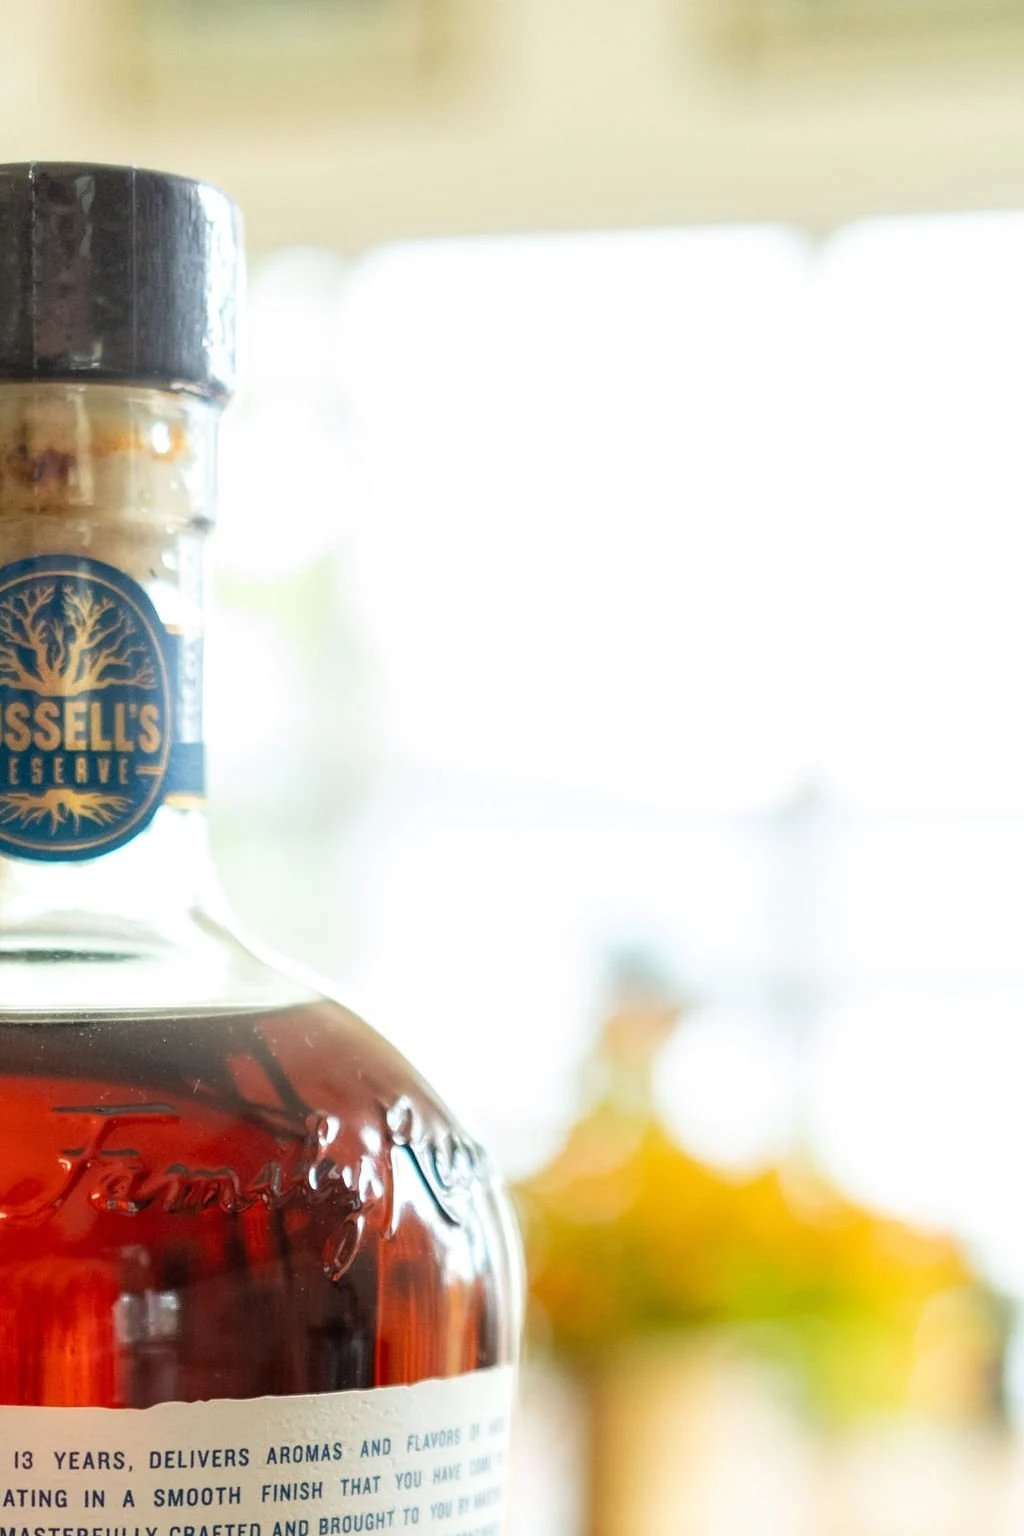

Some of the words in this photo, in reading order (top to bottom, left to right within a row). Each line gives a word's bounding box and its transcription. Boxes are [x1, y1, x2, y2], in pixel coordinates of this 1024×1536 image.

[14, 1451, 33, 1470] 13
[54, 1451, 133, 1473] YEARS,
[150, 1448, 249, 1469] DELIVERS
[266, 1442, 342, 1465] AROMAS
[360, 1438, 391, 1458] AND
[407, 1428, 461, 1453] FLAVORS
[84, 1490, 105, 1508] IN
[122, 1490, 135, 1508] A
[153, 1486, 241, 1507] SMOOTH
[262, 1481, 323, 1503] FINISH
[340, 1476, 381, 1496] THAT
[395, 1470, 422, 1490] YOU
[433, 1464, 461, 1485] HAVE
[319, 1510, 395, 1536] BROUGHT
[403, 1507, 419, 1526] TO
[430, 1499, 452, 1520] YOU
